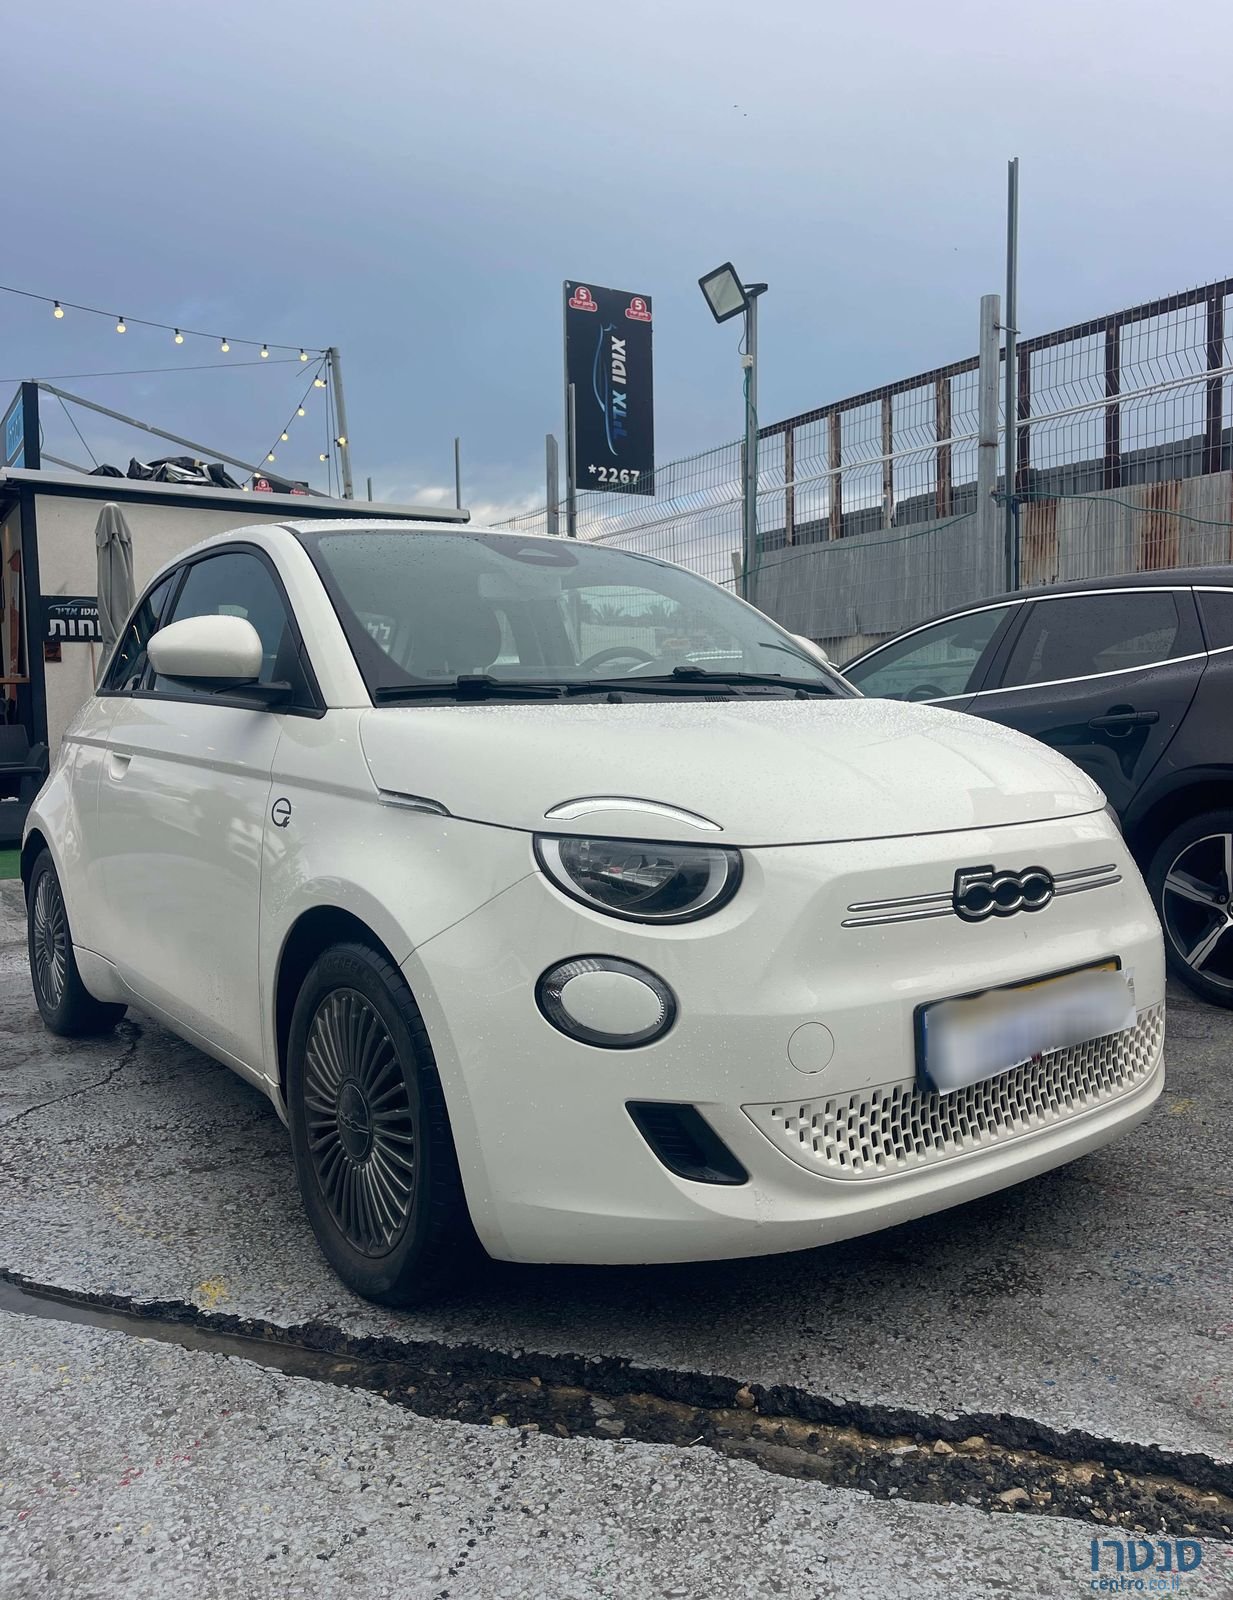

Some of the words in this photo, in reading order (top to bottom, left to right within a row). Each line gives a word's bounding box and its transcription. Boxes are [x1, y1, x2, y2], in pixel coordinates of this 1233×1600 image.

[611, 335, 627, 385] אוטו
[55, 607, 78, 616] אדיר
[952, 864, 1054, 923] 500
